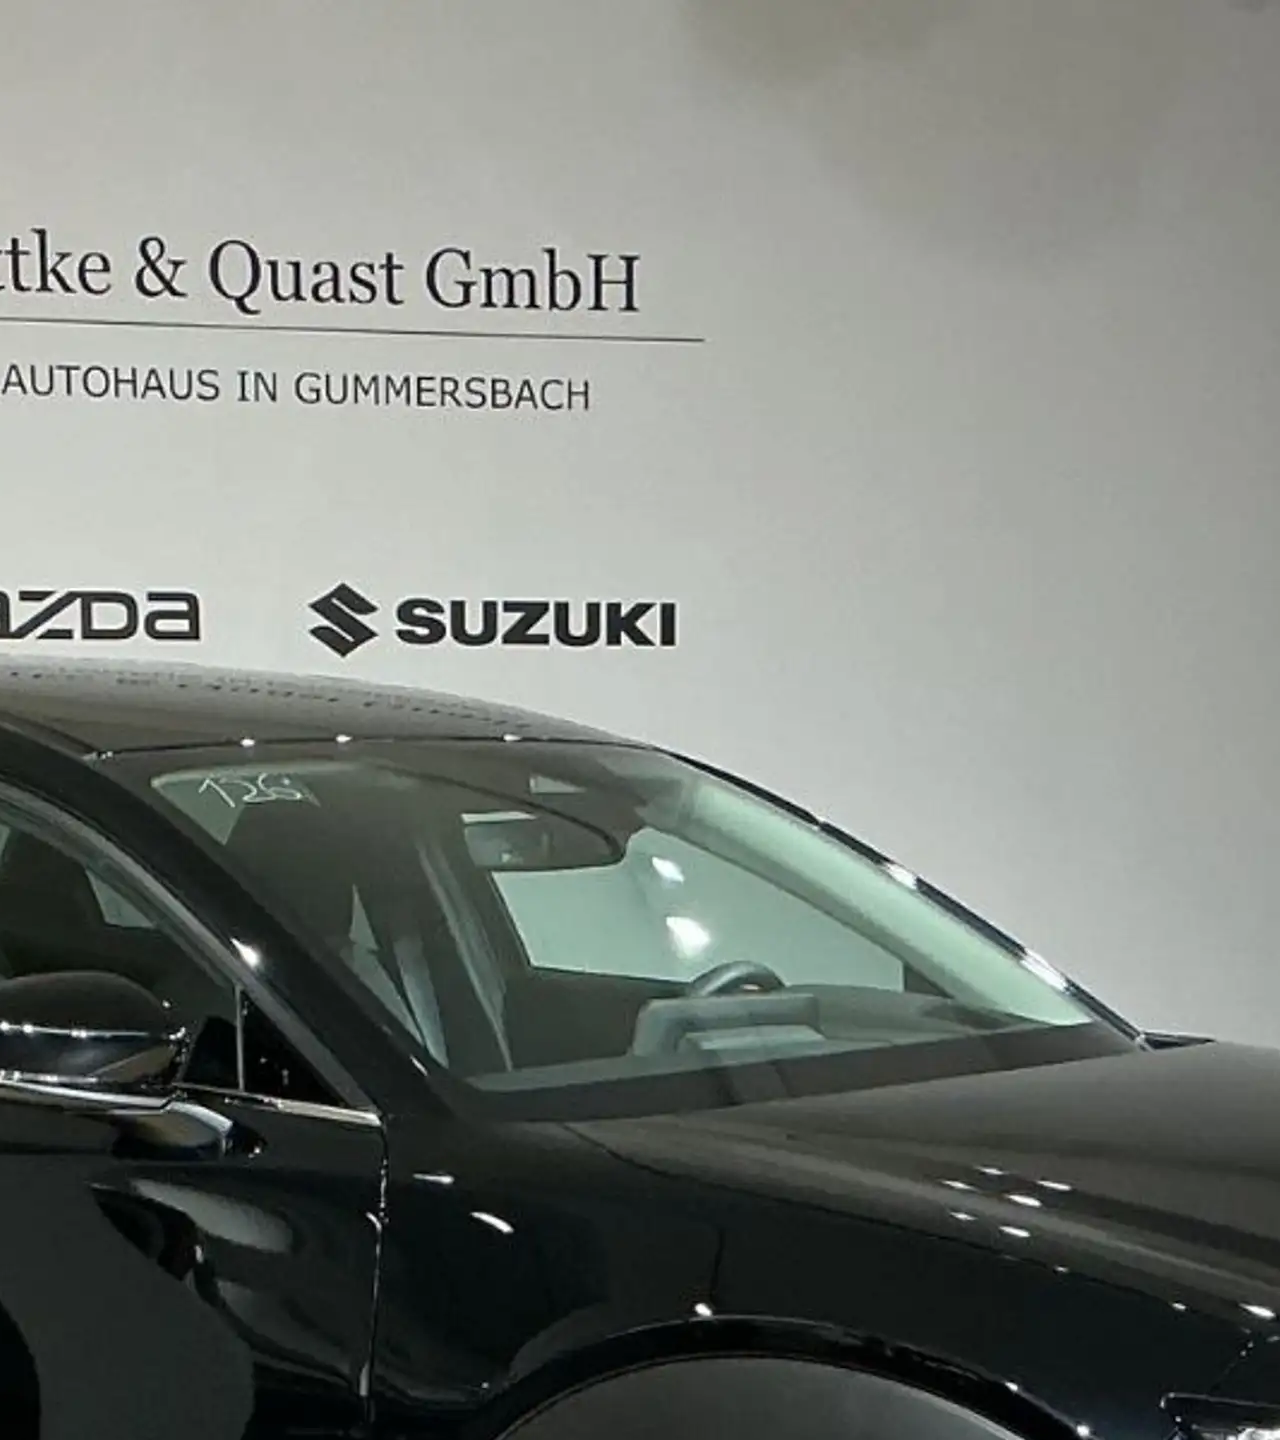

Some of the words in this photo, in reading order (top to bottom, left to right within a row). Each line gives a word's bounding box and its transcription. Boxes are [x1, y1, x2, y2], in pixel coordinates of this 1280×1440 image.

[135, 237, 188, 299] &
[209, 240, 405, 315] Quast
[426, 248, 641, 312] GmbH
[1, 364, 220, 402] AUTOHAUS
[237, 371, 278, 403] IN
[295, 372, 590, 411] GUMMERSBACH
[396, 598, 677, 648] SUZUKI
